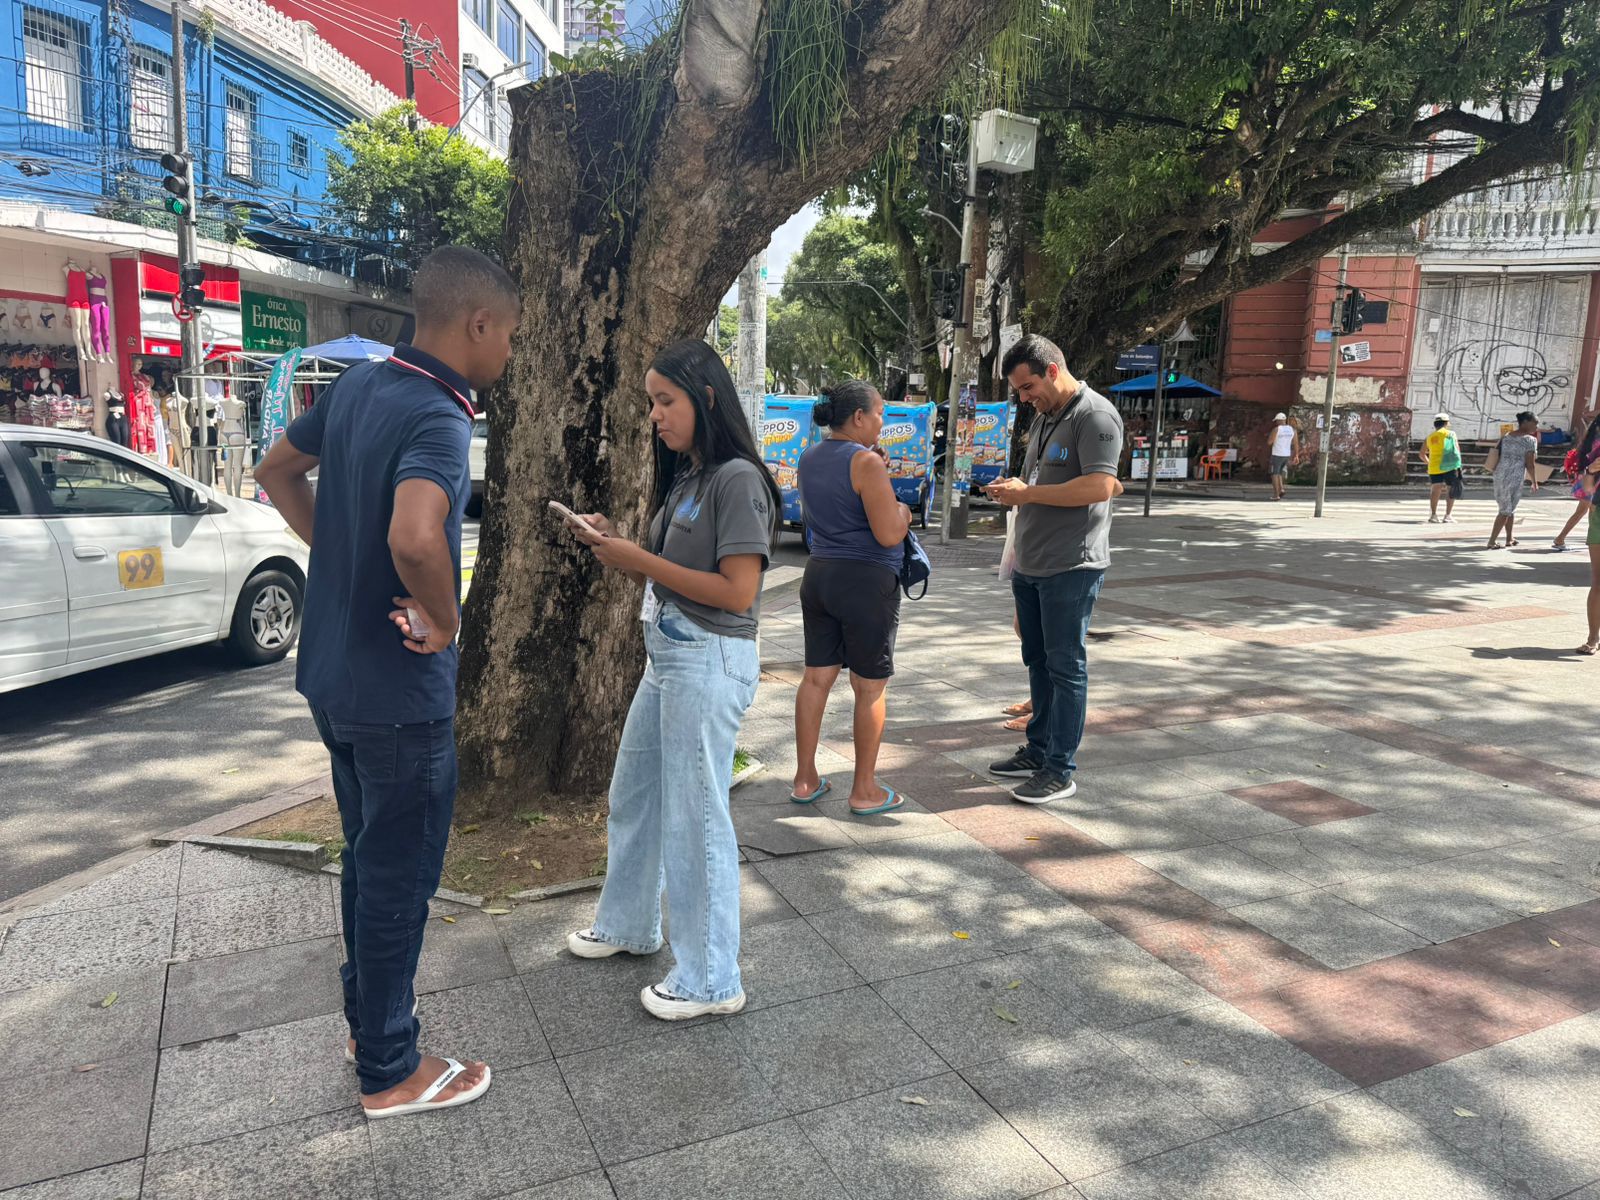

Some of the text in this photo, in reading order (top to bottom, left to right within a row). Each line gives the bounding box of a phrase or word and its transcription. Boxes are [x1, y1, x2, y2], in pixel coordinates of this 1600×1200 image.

[267, 298, 287, 311] ÓTICA
[252, 304, 301, 333] Ernesto
[1098, 433, 1114, 443] SSP
[125, 553, 155, 582] 99
